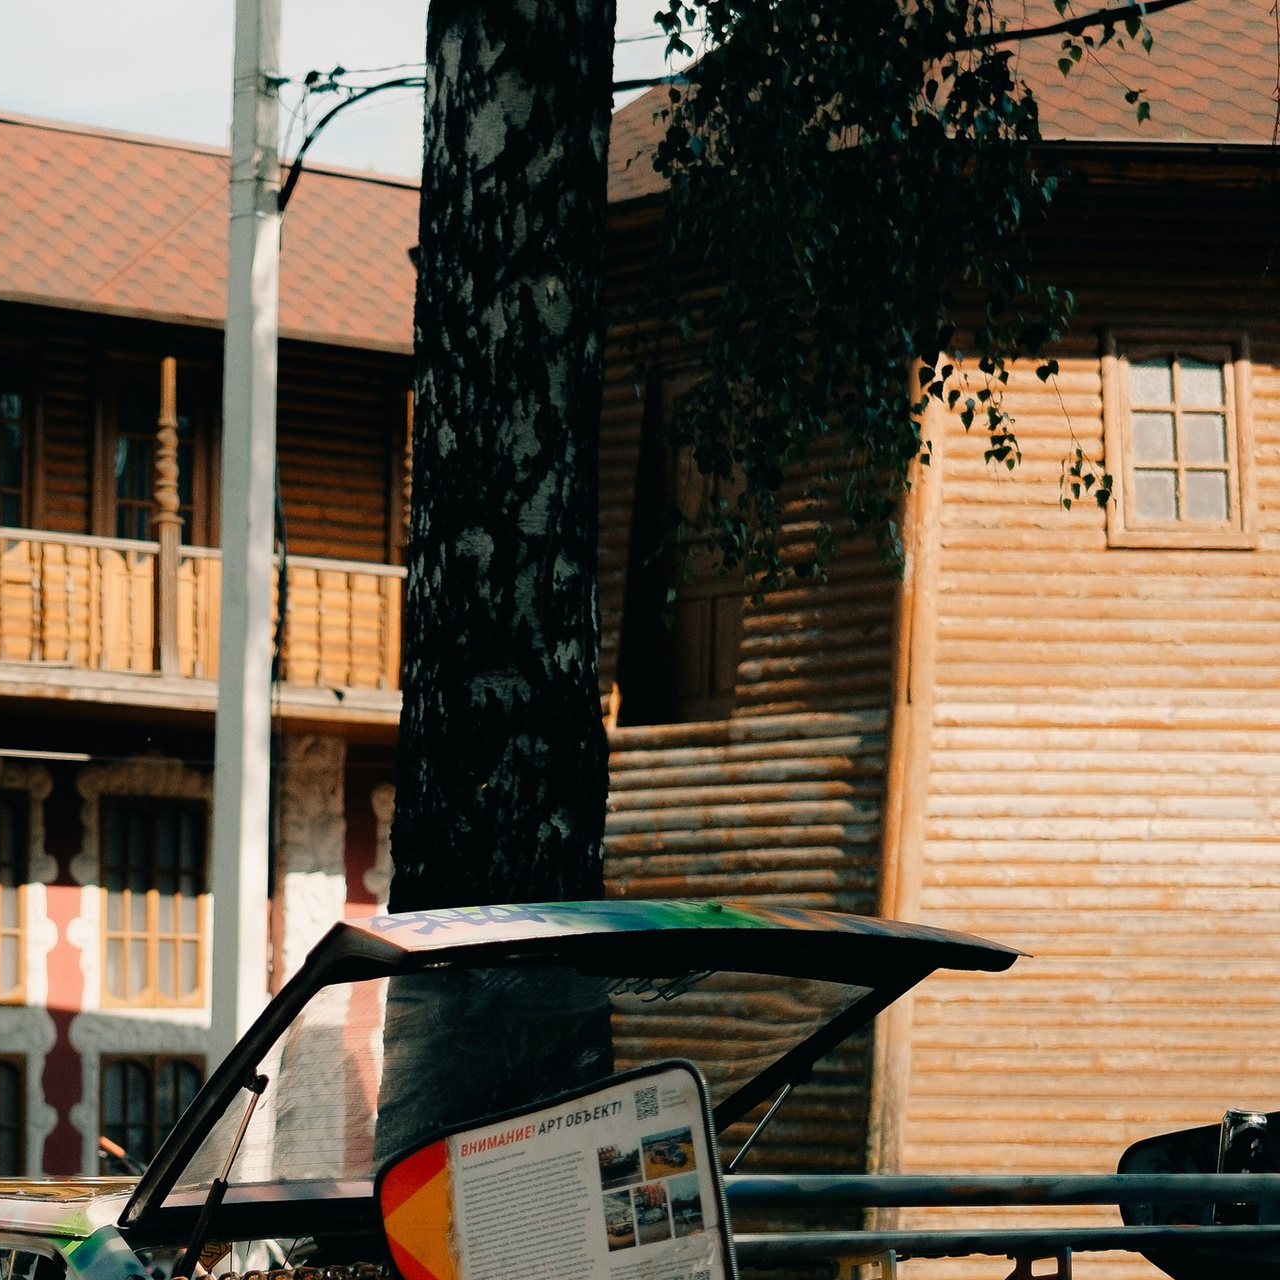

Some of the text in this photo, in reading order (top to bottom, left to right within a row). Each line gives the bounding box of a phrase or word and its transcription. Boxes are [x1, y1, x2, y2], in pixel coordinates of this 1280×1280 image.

[460, 1100, 622, 1158] ВНИМАНИЕ! АРТ ОБЪЕКТ!
